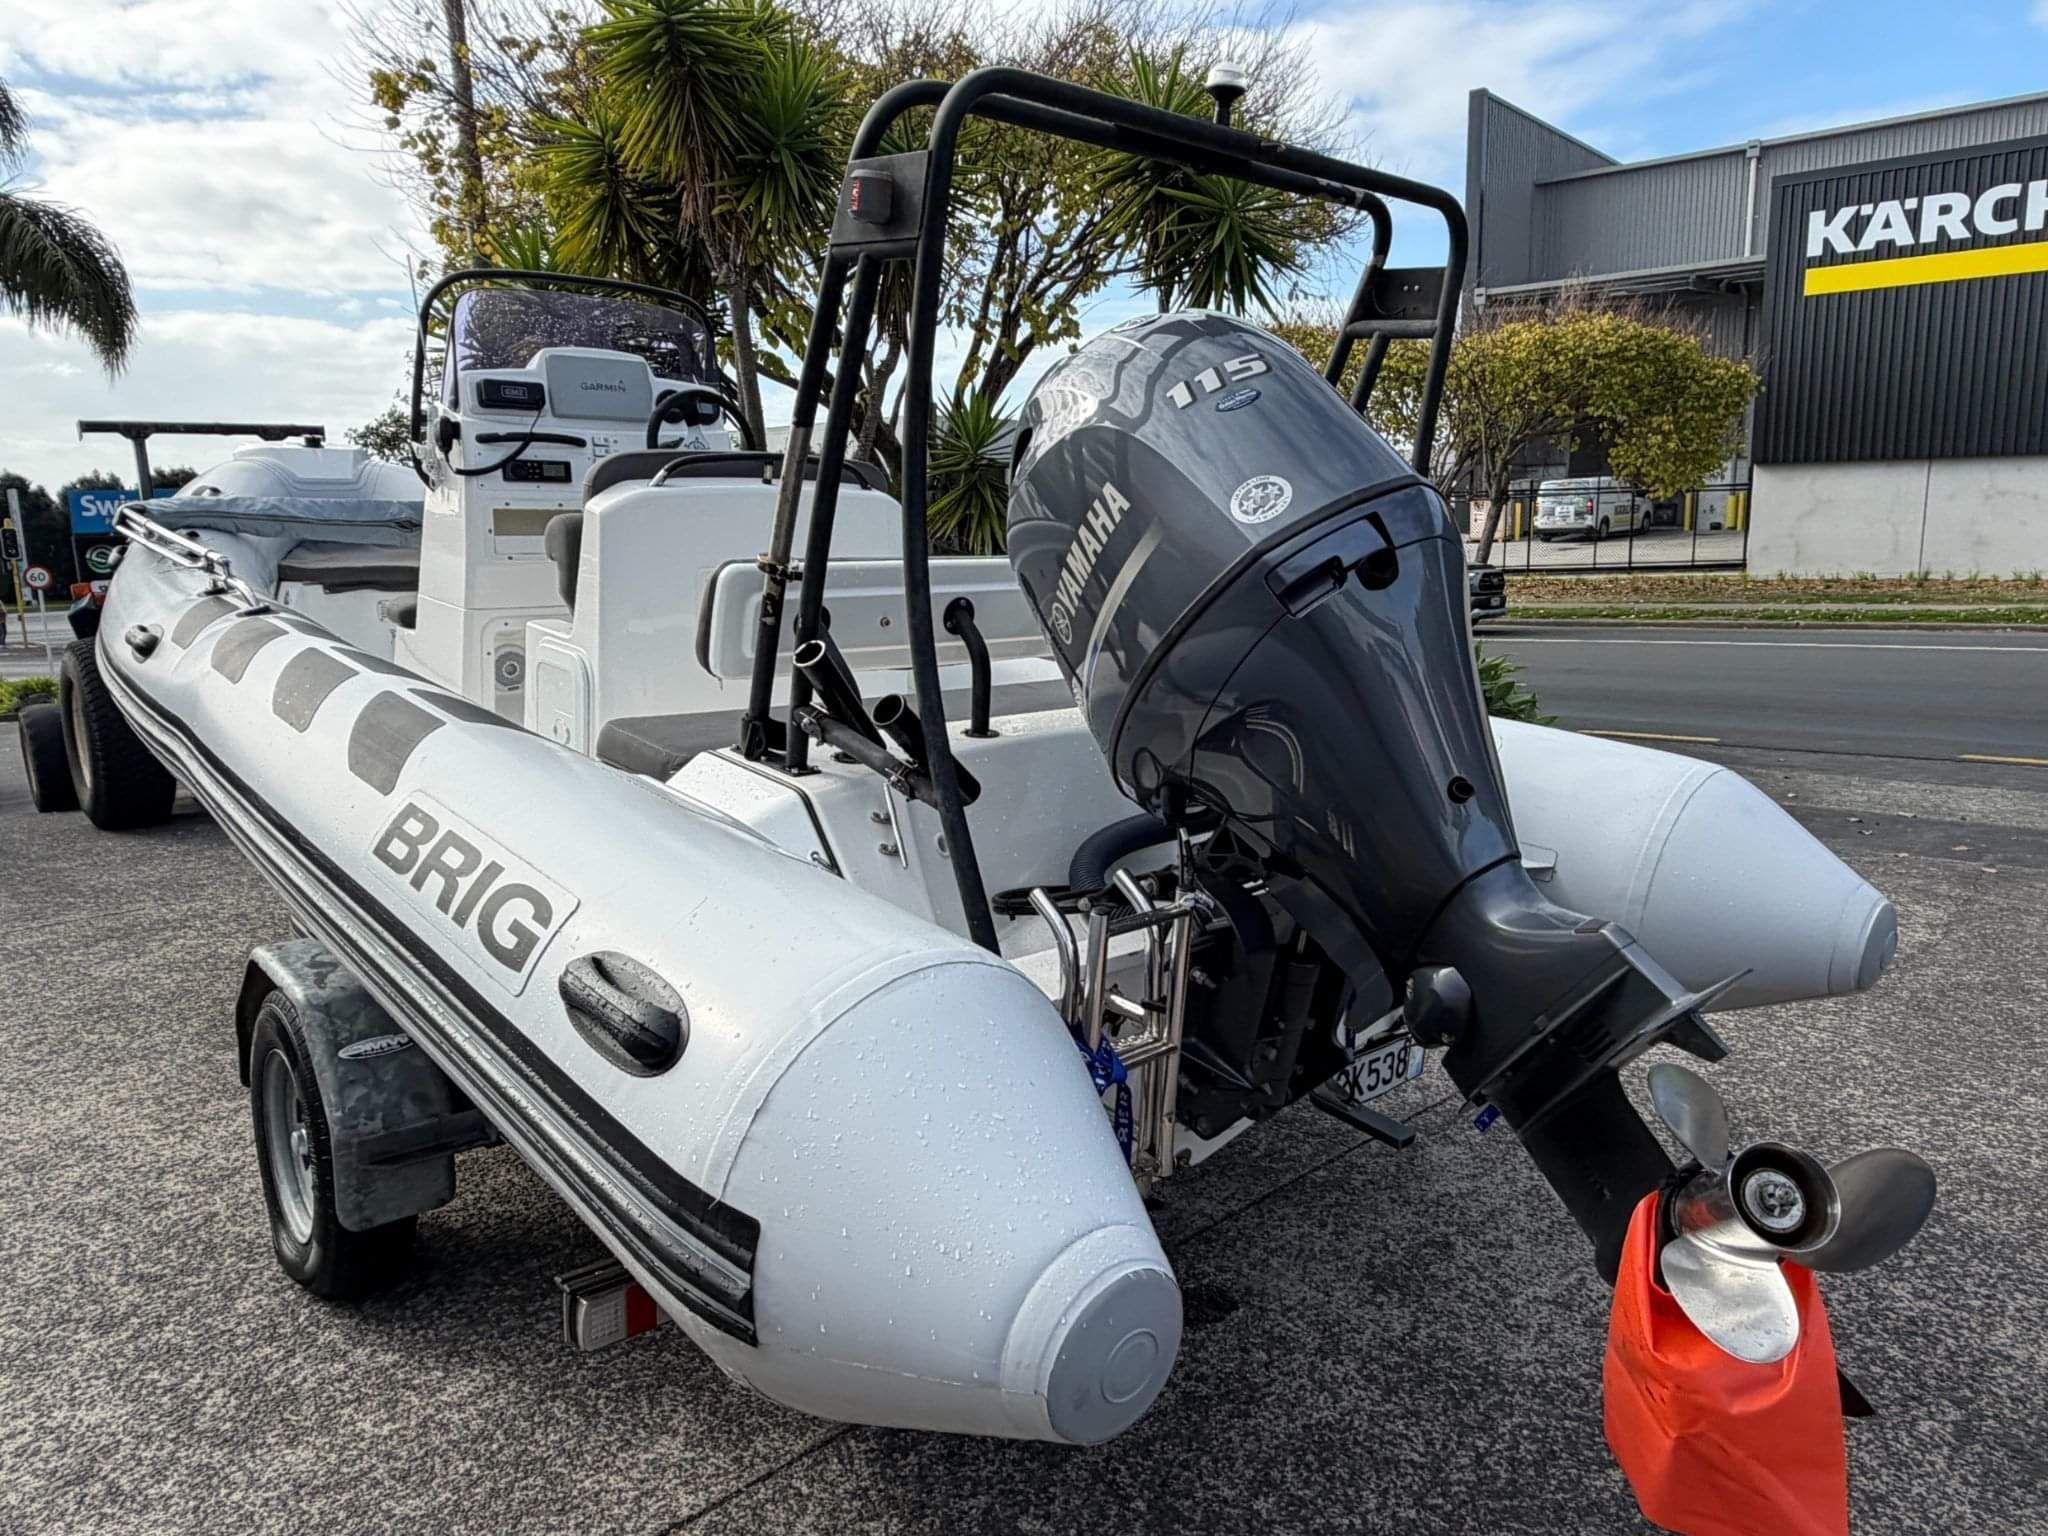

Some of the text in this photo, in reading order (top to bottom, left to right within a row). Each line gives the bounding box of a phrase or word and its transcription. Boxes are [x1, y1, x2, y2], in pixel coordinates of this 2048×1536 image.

[580, 382, 626, 393] GARMIN
[1165, 353, 1267, 409] 115
[30, 571, 46, 583] 60
[1055, 481, 1132, 617] YAMAHA
[373, 801, 554, 974] BRIG
